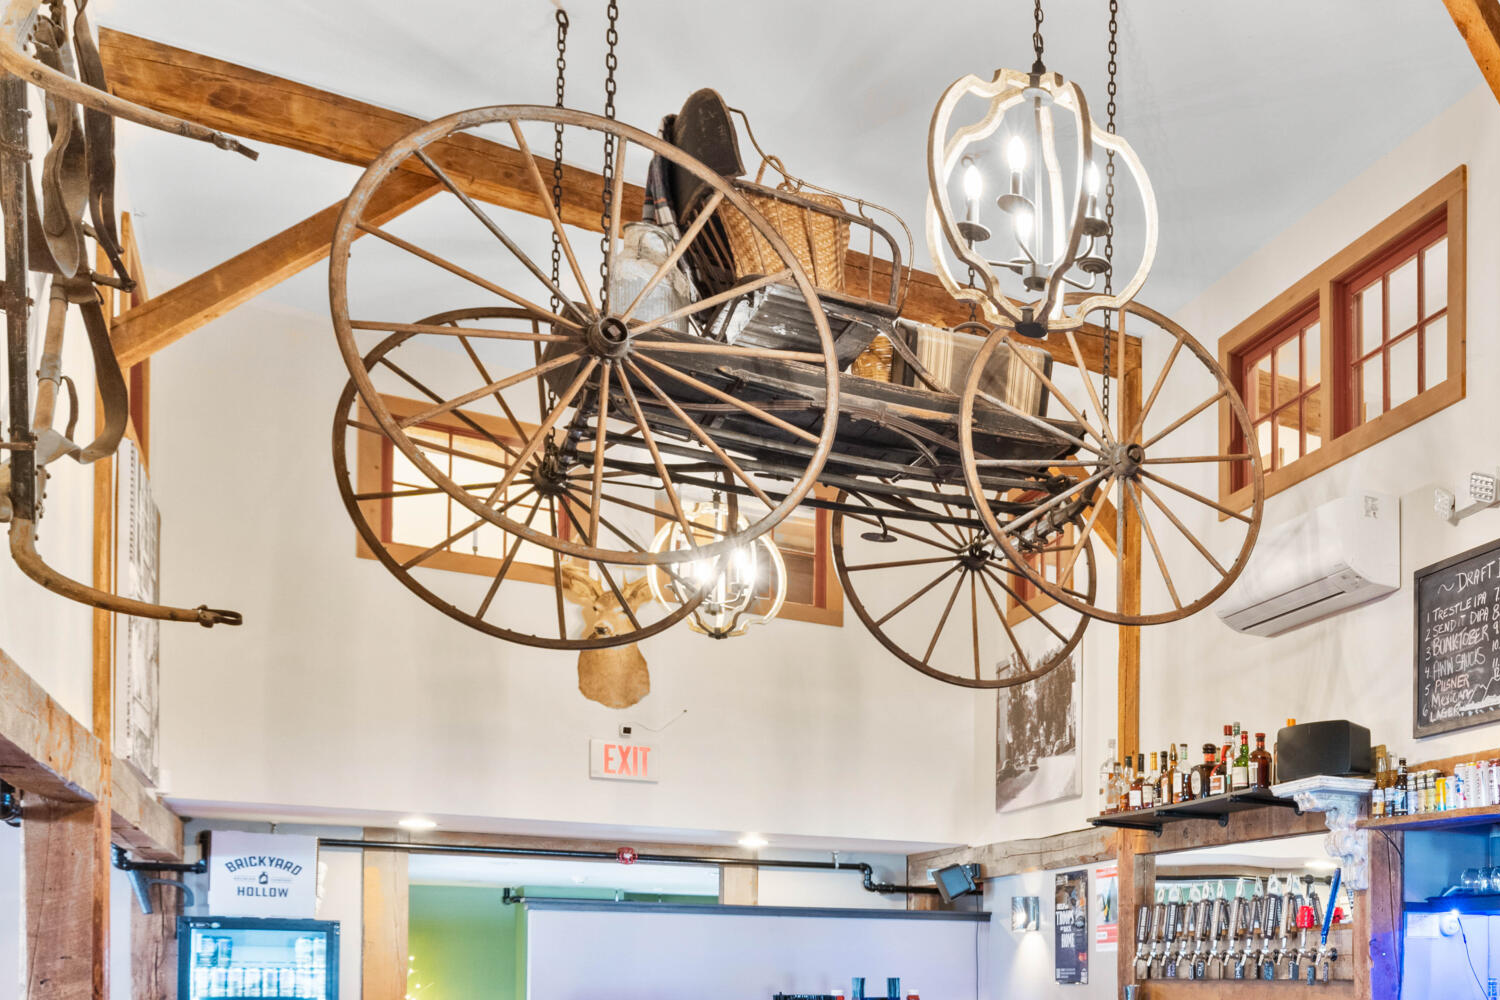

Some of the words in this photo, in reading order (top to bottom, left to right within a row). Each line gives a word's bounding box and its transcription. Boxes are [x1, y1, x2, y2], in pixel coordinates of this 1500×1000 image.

[1456, 560, 1496, 593] DRAFT
[1433, 598, 1471, 622] TRESTLE
[1473, 591, 1487, 608] IPA
[1433, 620, 1457, 638] SEND
[1434, 673, 1470, 694] PILSNER
[603, 744, 651, 776] EXIT
[225, 856, 303, 876] BRICKYARD
[237, 886, 289, 898] HOLLOW
